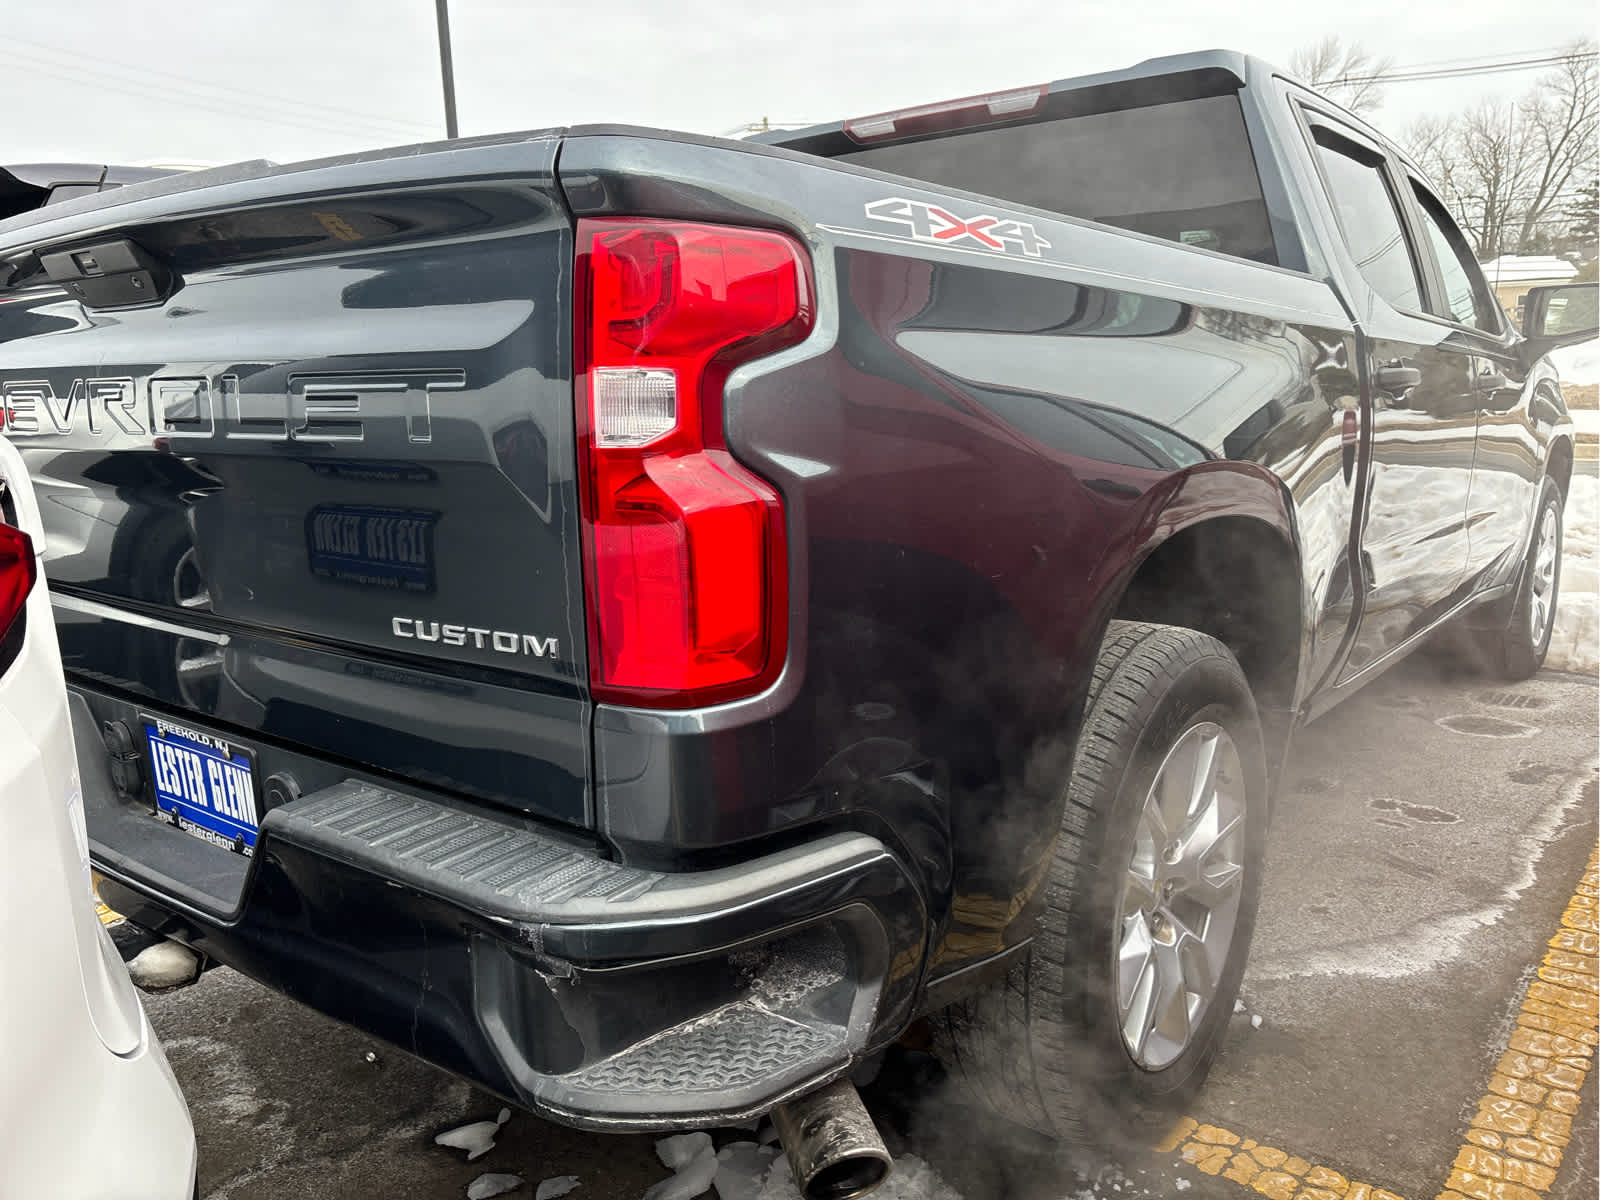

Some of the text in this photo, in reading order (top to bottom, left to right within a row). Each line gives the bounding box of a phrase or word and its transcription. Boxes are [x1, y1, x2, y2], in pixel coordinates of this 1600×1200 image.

[392, 617, 559, 659] CUSTOM
[156, 720, 213, 749] FREEHOLD,
[150, 740, 259, 827] LESTER GLENN
[178, 818, 235, 850] lesterglenn
